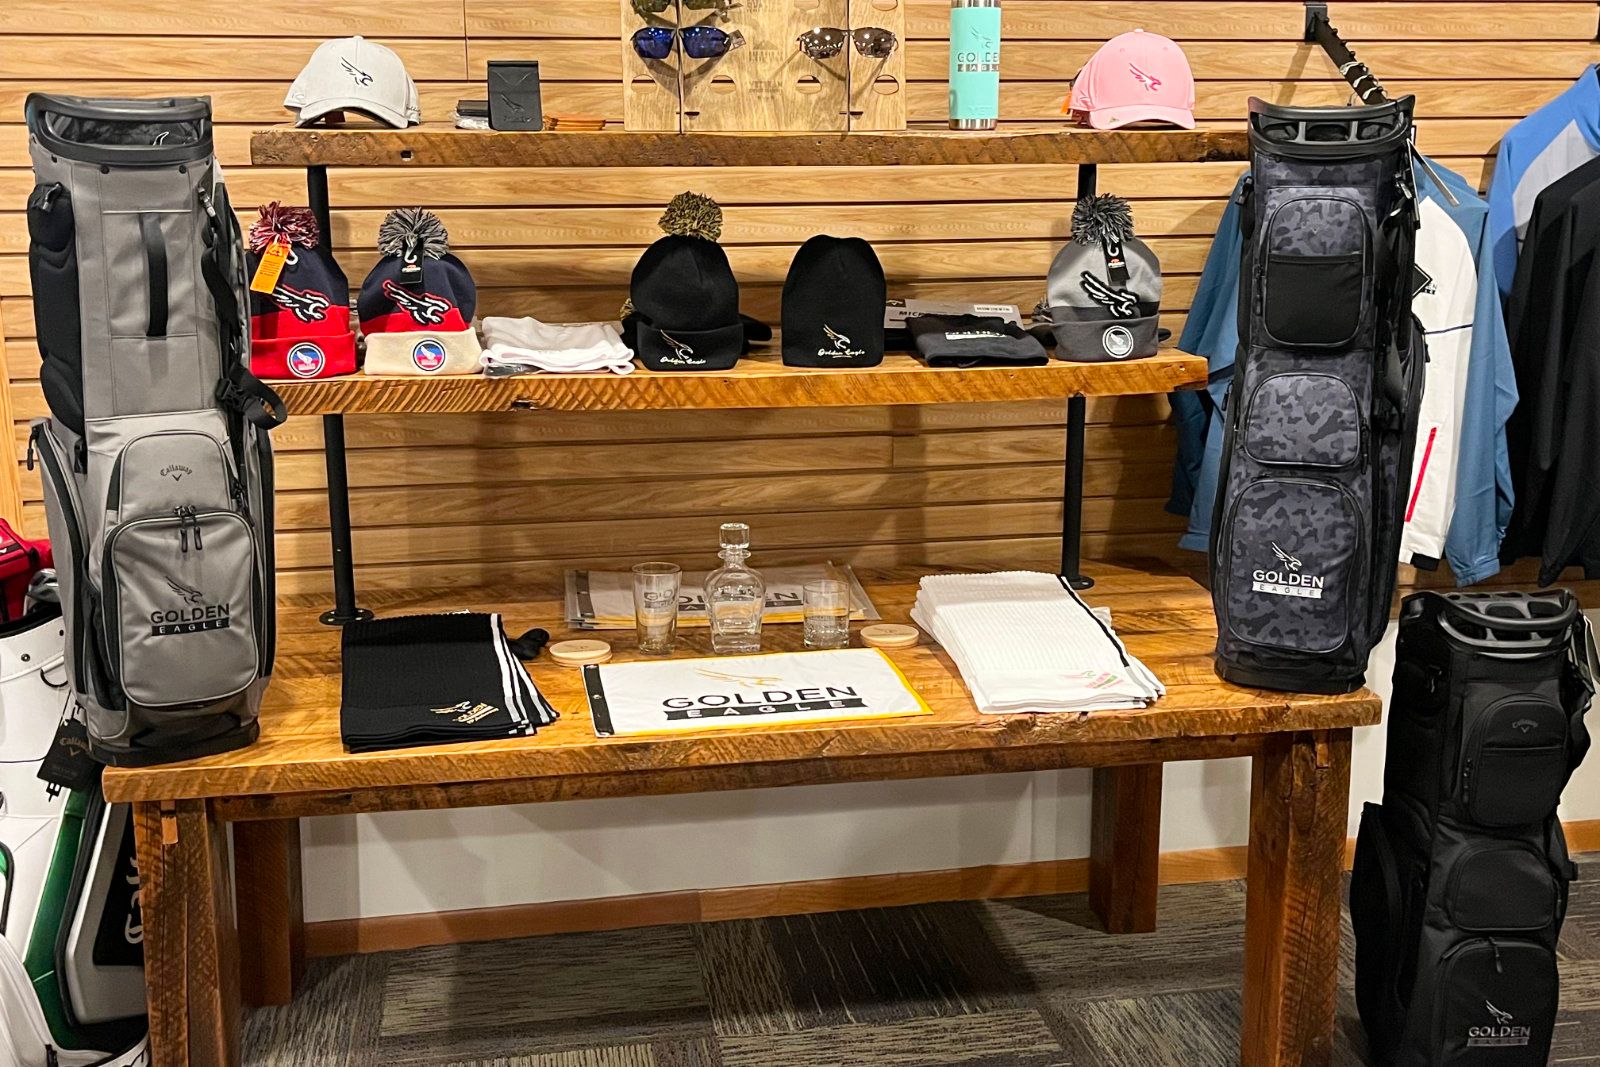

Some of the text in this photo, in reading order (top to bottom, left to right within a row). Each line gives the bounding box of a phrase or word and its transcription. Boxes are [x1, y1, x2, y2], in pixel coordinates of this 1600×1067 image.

[957, 52, 999, 62] GOLDE
[160, 464, 193, 476] Callaway
[1252, 569, 1325, 589] GOLDEN
[1259, 583, 1315, 597] EAGLE
[150, 602, 230, 624] GOLDEN
[159, 619, 223, 634] EAGLE
[662, 686, 858, 709] GOLDEN
[686, 700, 846, 718] EAGLE
[1468, 1026, 1531, 1037] GOLDEN
